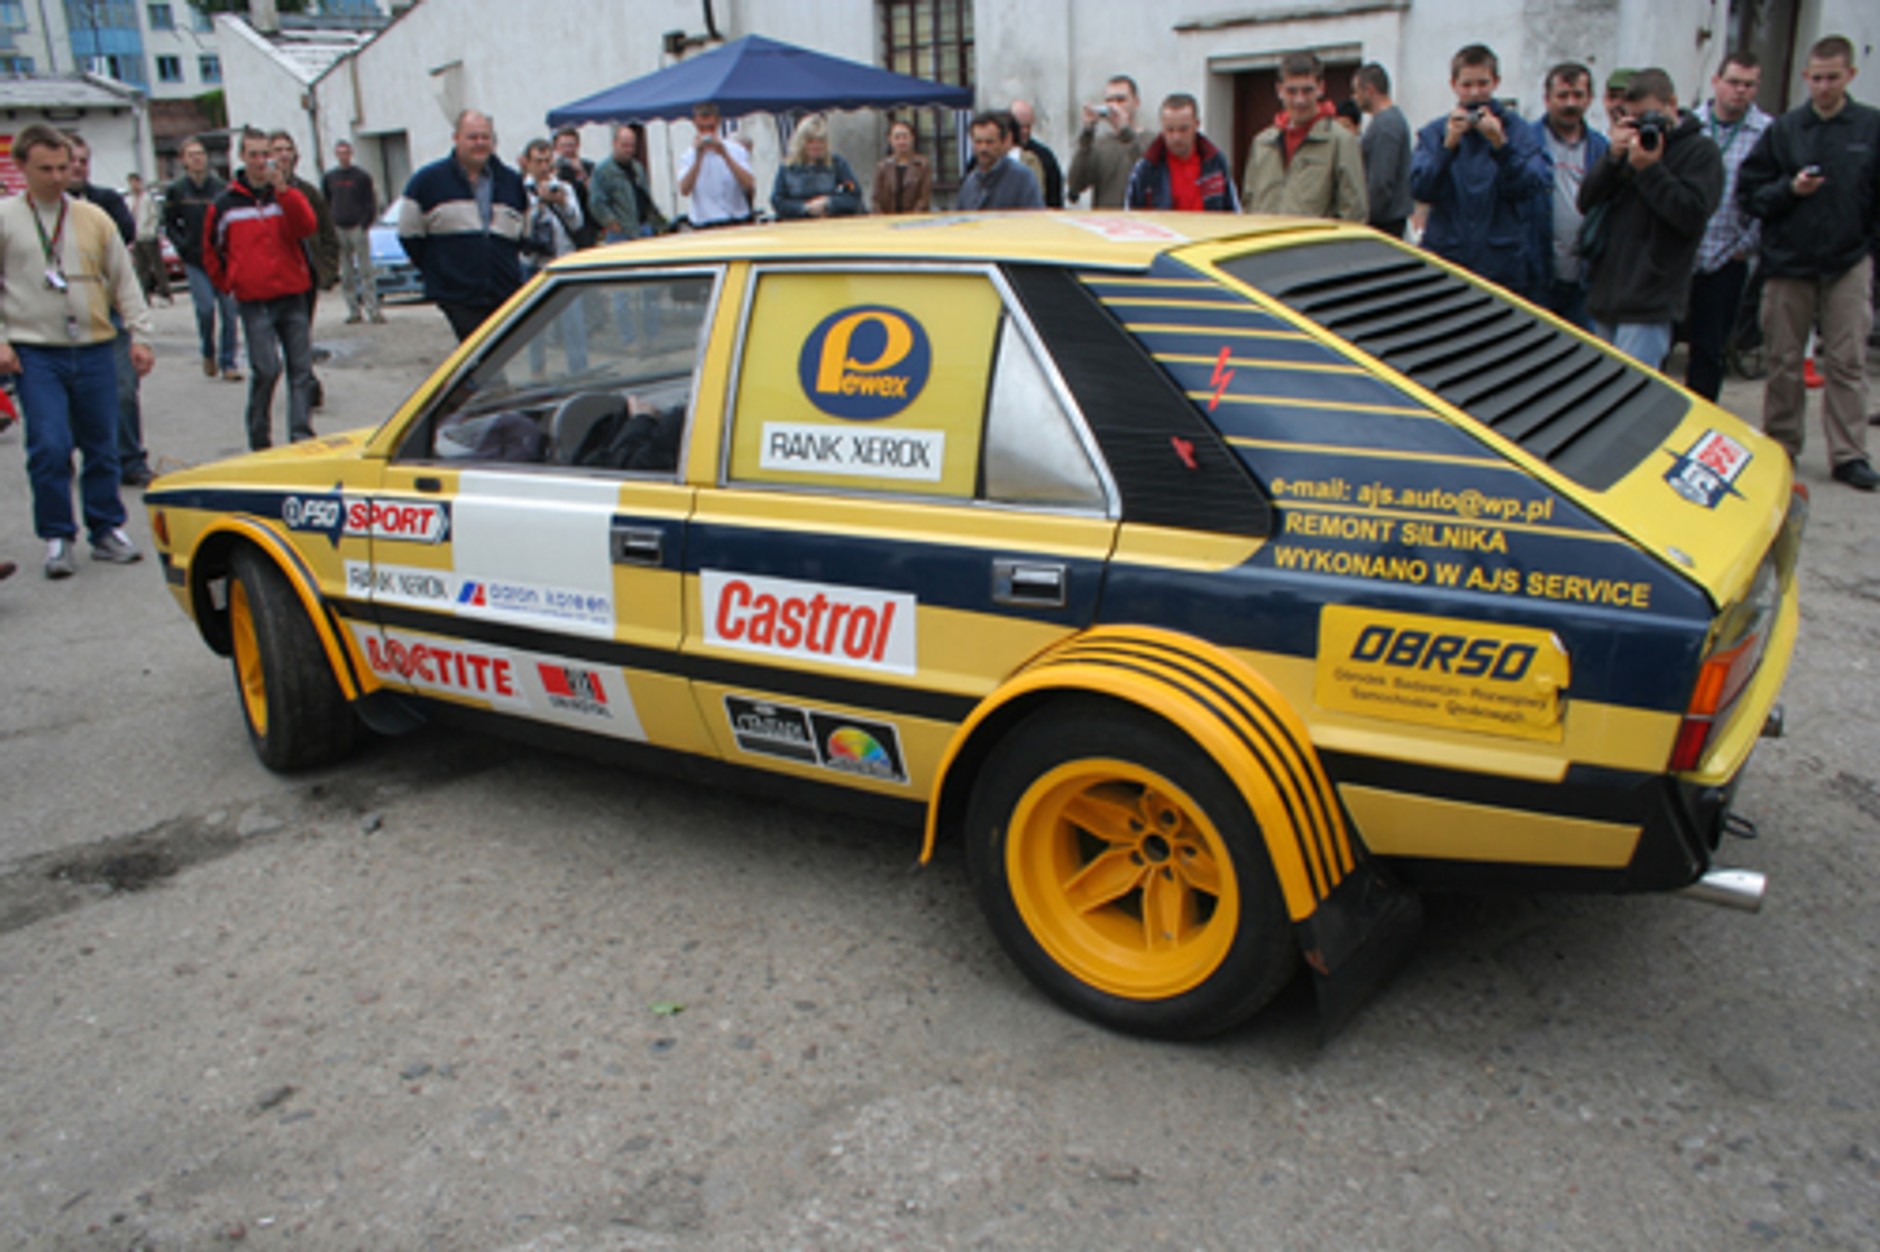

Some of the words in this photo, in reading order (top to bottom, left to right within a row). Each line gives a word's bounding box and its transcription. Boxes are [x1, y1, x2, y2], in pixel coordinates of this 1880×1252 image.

[770, 432, 843, 463] RANK
[850, 436, 931, 469] XEROX
[349, 503, 436, 535] SPORT
[1270, 478, 1351, 502] e-mail:
[1357, 482, 1554, 521] ajs.auto@wp.pl
[1285, 512, 1396, 541] REMONT
[1400, 523, 1508, 553] SILNIKA
[1274, 546, 1428, 583] WYKONANO
[1434, 563, 1463, 587] W
[1465, 567, 1520, 593] AJS
[1526, 574, 1651, 608] SERVICE
[716, 579, 897, 662] Castrol
[365, 635, 515, 696] LOCTITE
[1350, 624, 1540, 682] OBRSO
